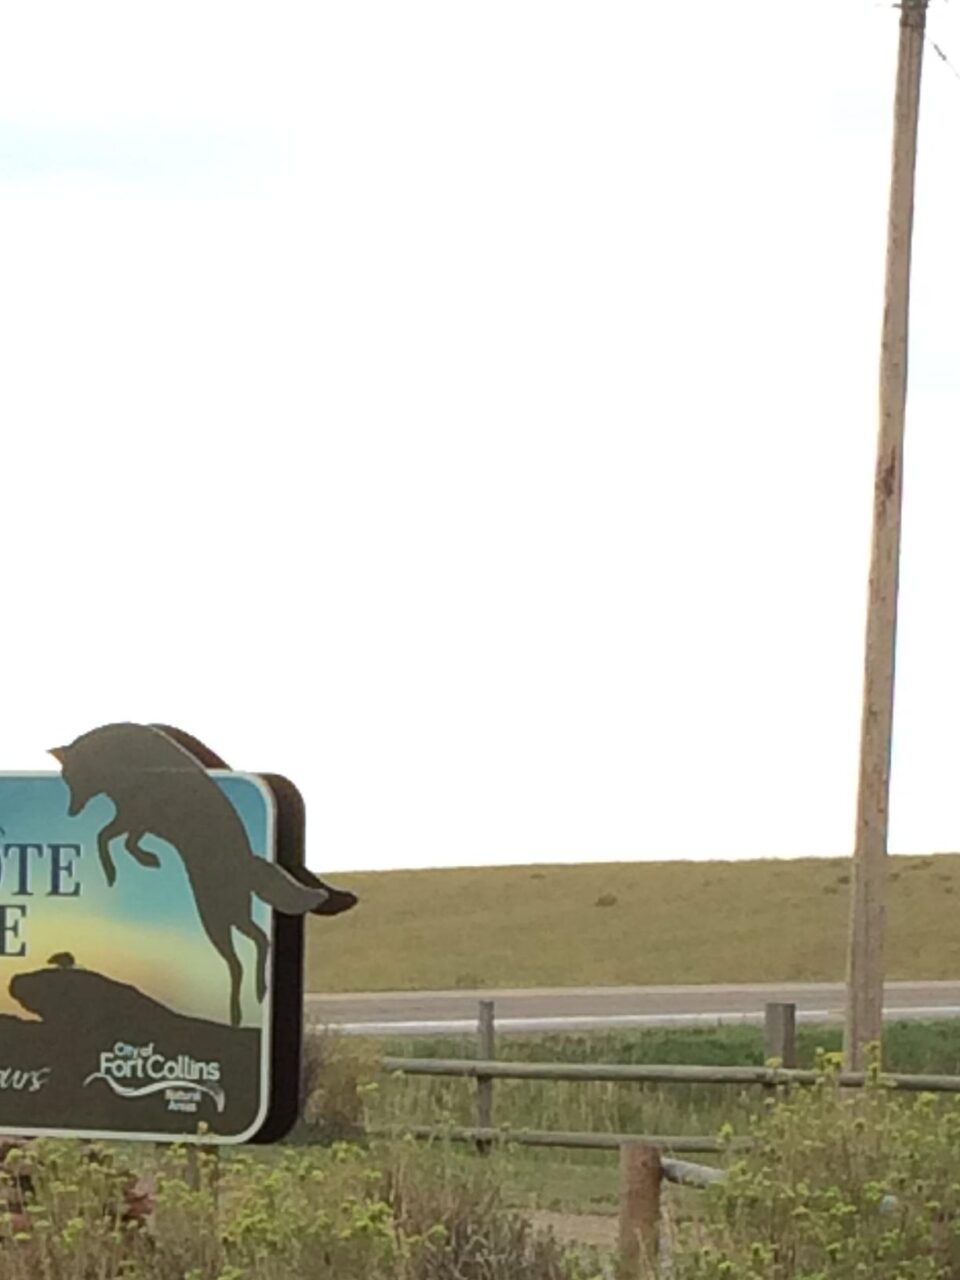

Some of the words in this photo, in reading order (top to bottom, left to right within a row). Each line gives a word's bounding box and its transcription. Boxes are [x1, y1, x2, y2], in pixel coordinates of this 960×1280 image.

[114, 1041, 139, 1058] City
[140, 1041, 155, 1057] of
[100, 1051, 144, 1078] Fort
[145, 1054, 221, 1080] Collins
[165, 1088, 202, 1101] Natural
